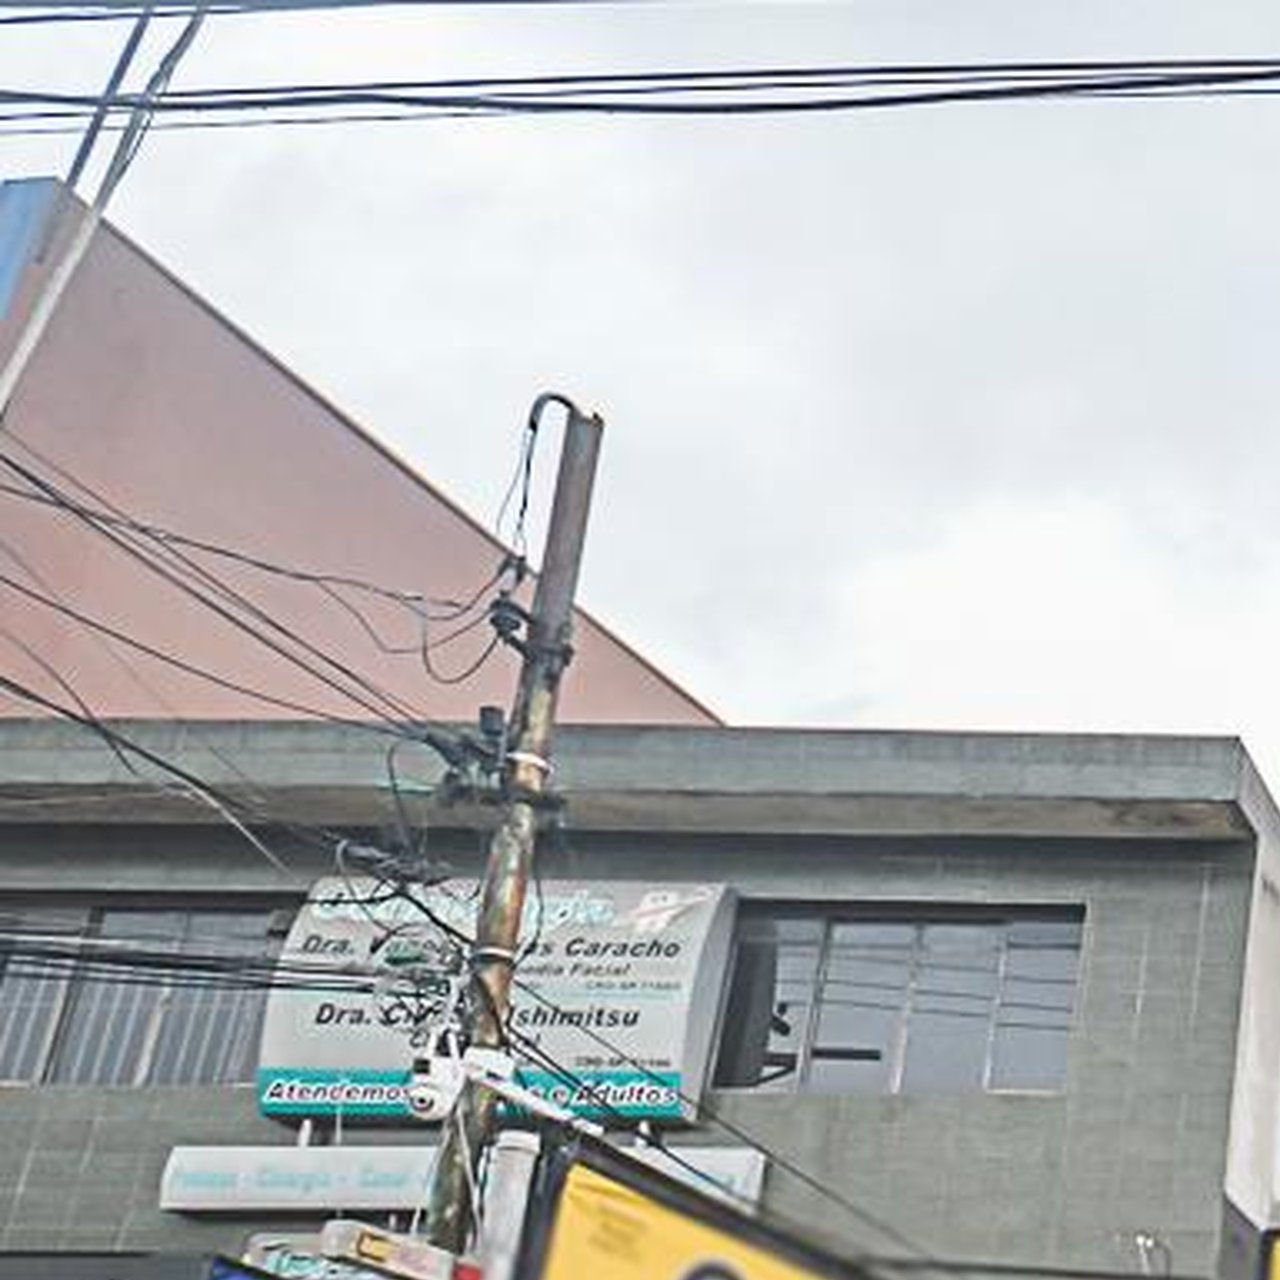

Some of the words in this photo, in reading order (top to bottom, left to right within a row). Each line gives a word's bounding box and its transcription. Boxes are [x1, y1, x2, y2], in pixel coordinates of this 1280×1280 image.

[302, 934, 355, 956] Dra.
[566, 936, 681, 958] Caracho
[315, 1003, 372, 1025] Dra.
[512, 1006, 640, 1027] shimitsu
[576, 1081, 678, 1103] Adultos
